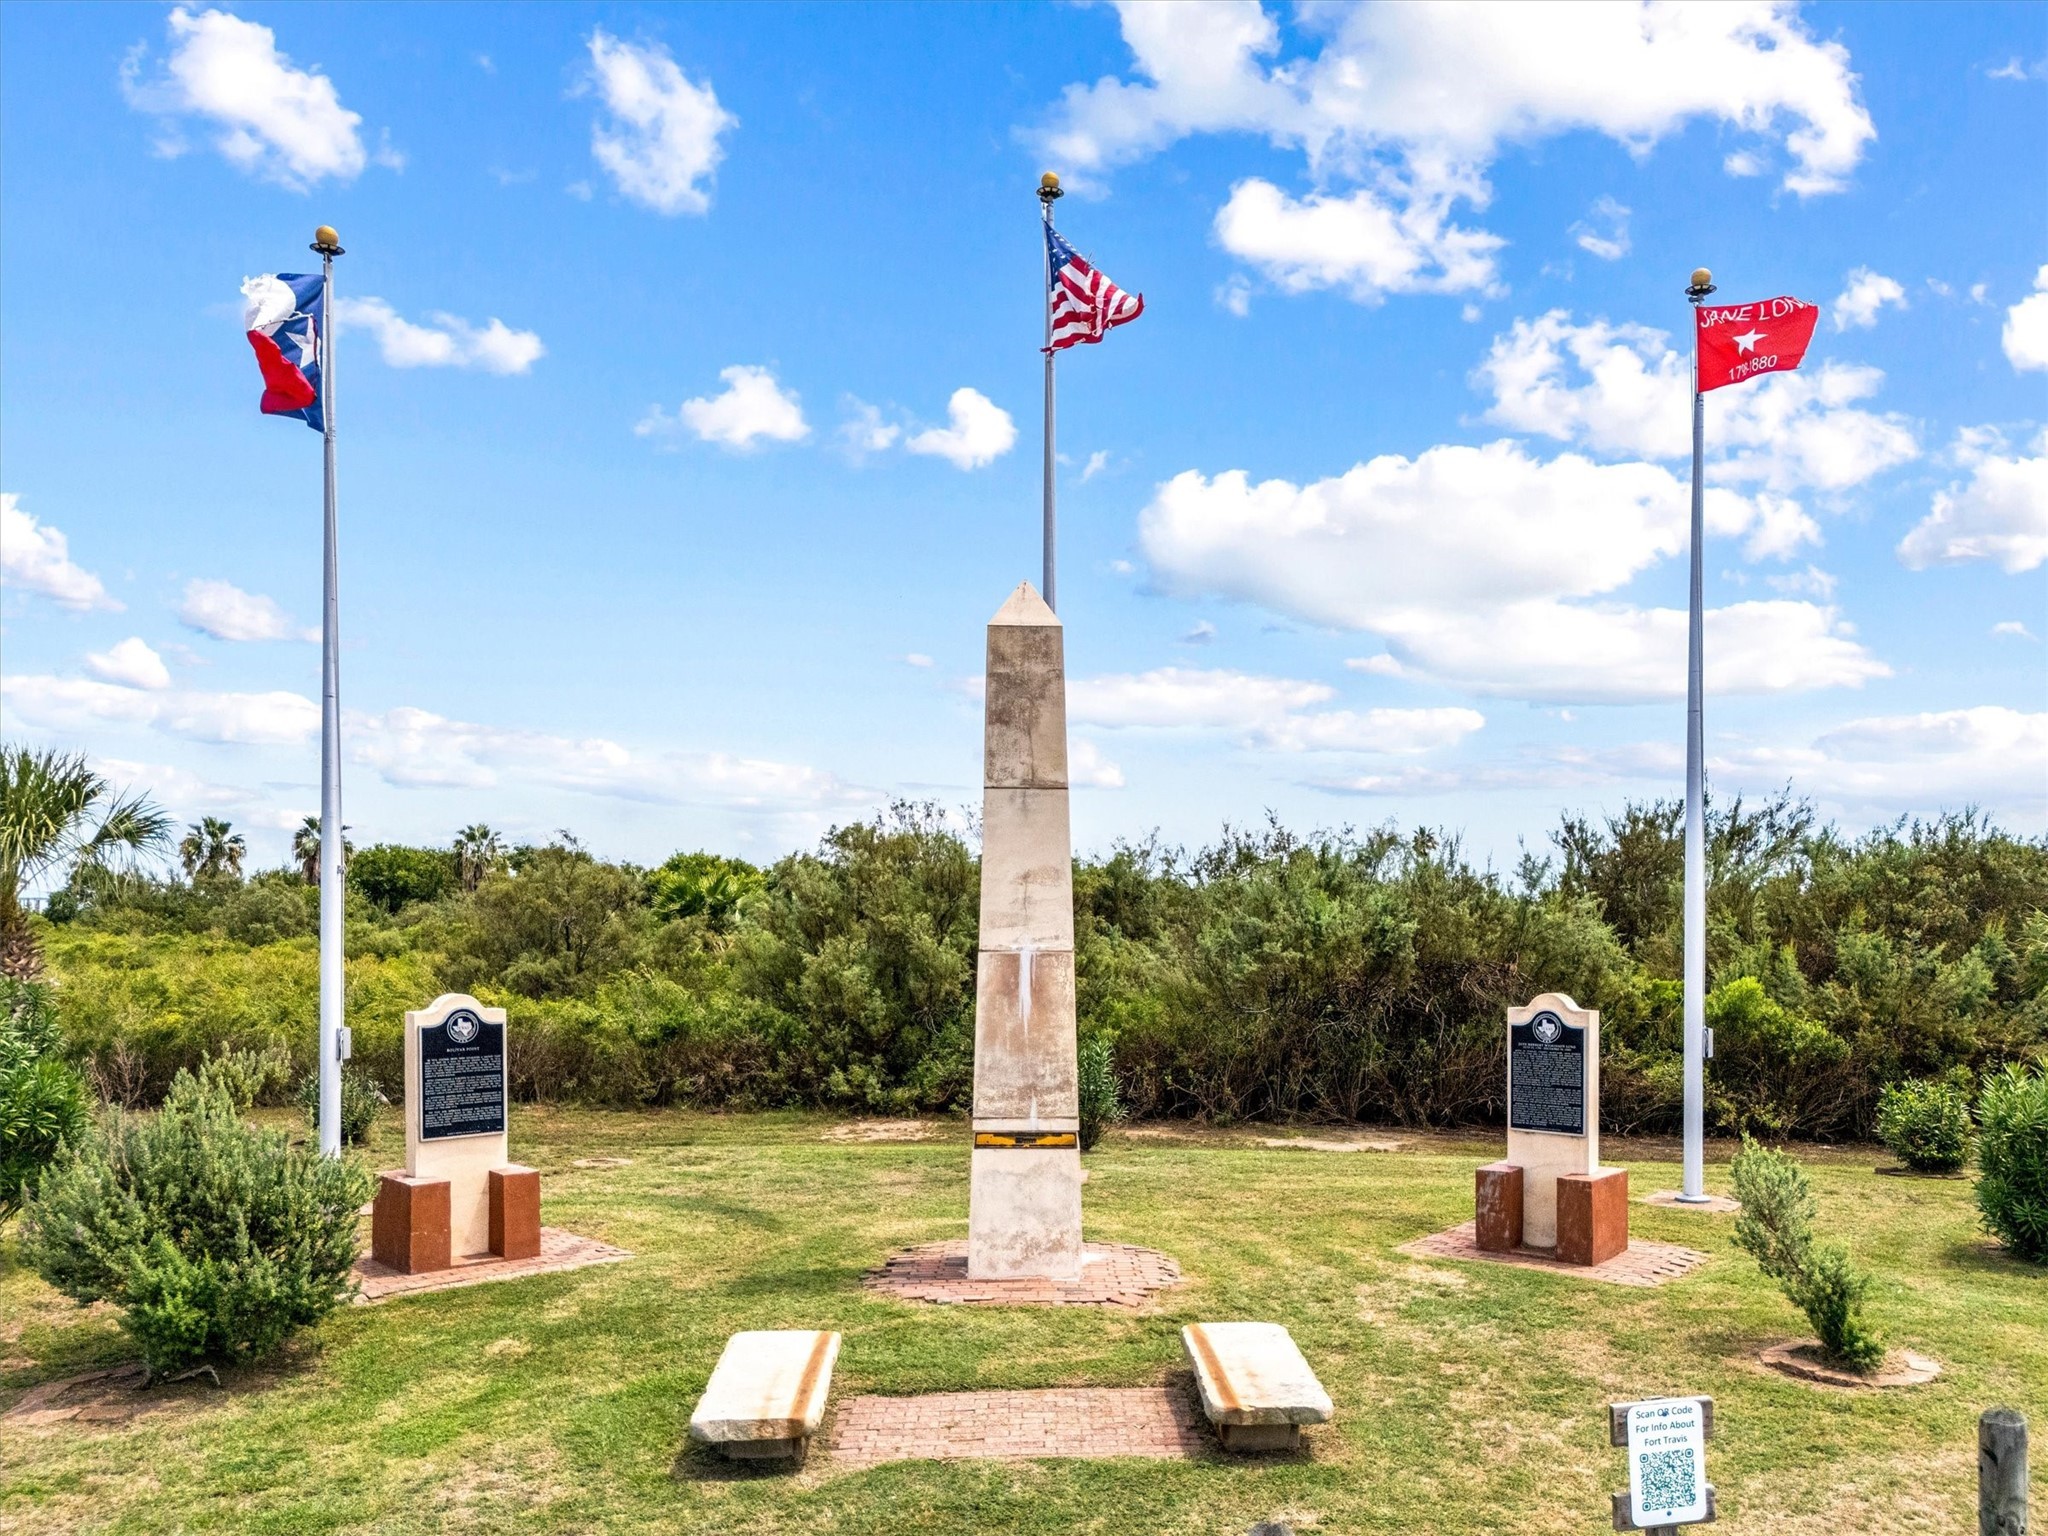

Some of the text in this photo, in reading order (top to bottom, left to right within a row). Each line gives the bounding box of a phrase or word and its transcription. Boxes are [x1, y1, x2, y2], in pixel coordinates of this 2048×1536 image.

[1700, 306, 1753, 328] JANE
[1636, 1410, 1655, 1419] Scan
[1671, 1406, 1693, 1415] Code
[1635, 1420, 1695, 1433] For Info About
[1644, 1435, 1688, 1446] Fort Travis
